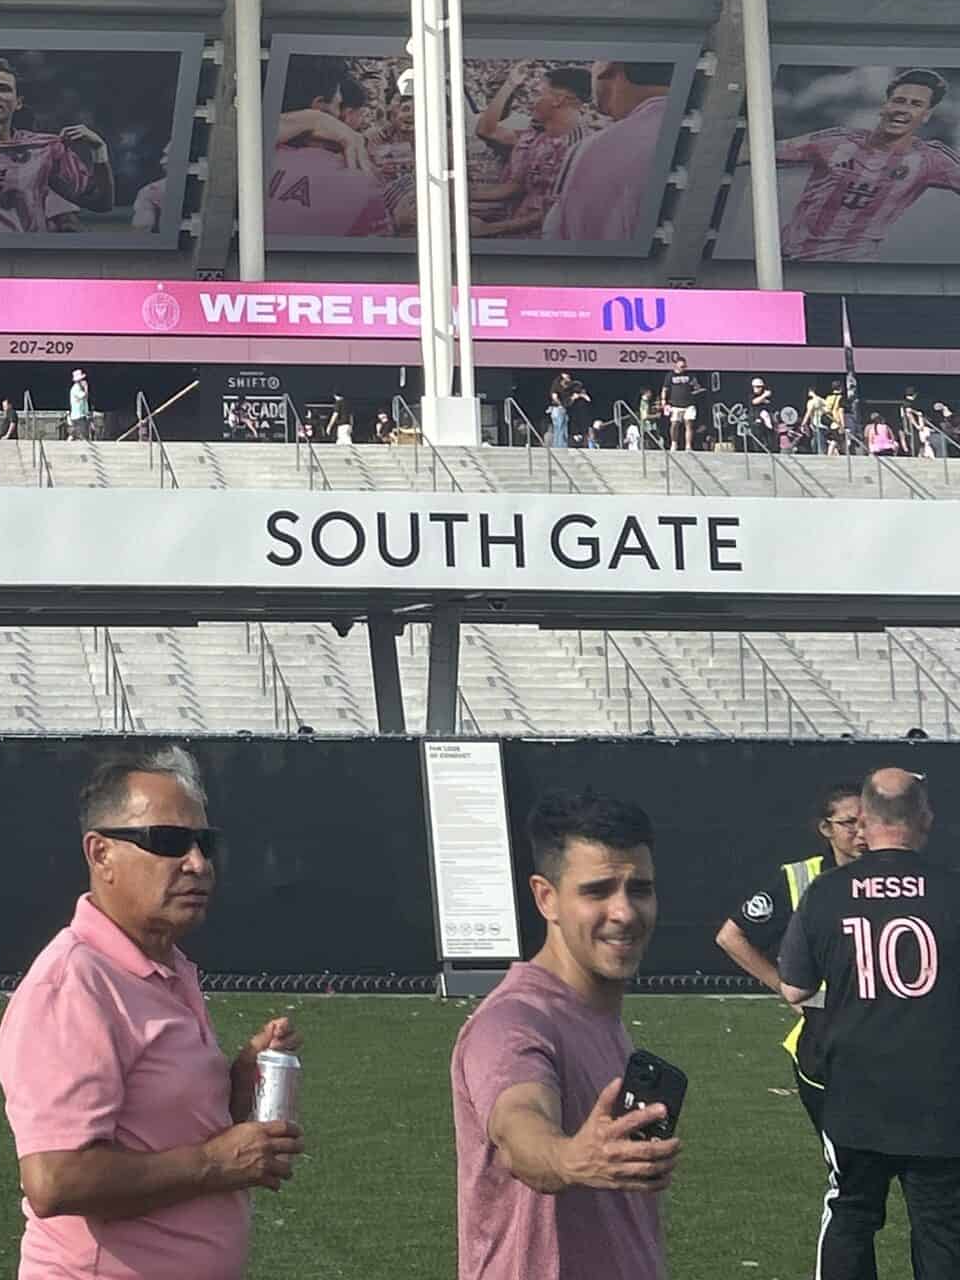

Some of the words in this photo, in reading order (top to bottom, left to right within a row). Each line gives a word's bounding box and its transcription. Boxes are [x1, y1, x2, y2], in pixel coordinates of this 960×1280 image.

[199, 293, 353, 325] WE'RE
[363, 296, 509, 328] HOE
[266, 509, 526, 568] SOUTH
[550, 513, 742, 572] GATE
[852, 876, 925, 899] MESSI
[842, 915, 938, 1000] 10
